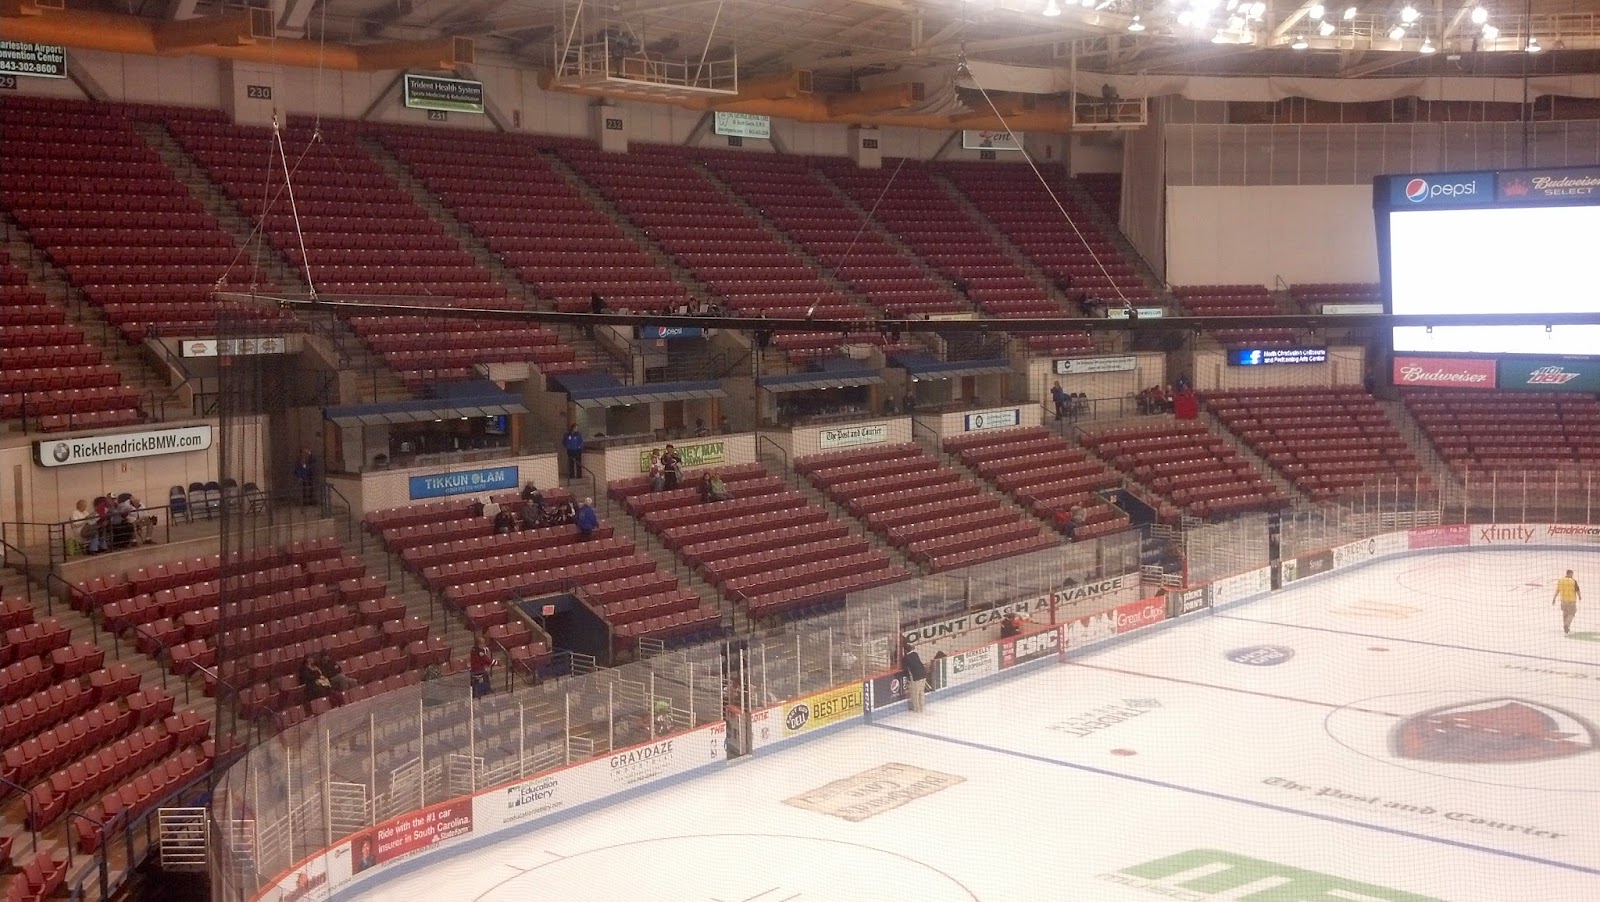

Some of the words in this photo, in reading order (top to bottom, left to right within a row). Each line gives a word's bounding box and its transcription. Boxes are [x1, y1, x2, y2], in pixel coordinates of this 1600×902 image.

[37, 53, 63, 63] Center
[0, 61, 57, 73] 843-302-8600
[250, 88, 270, 98] 230
[411, 80, 434, 90] Trident
[435, 82, 457, 92] Health
[458, 85, 480, 95] System
[431, 112, 445, 120] 231
[607, 120, 622, 129] 232
[1431, 180, 1476, 198] pepsi
[1544, 187, 1593, 196] SELECT
[667, 327, 683, 336] pepsi
[1400, 365, 1487, 383] Budweiser
[826, 431, 837, 441] The
[837, 430, 850, 441] Post
[851, 428, 860, 437] and
[861, 426, 882, 437] Courier
[73, 433, 202, 459] RickHendrickBMW.com
[703, 443, 724, 456] MAN
[425, 474, 468, 489] TIKKUN
[1480, 525, 1535, 543] xfinity
[974, 602, 1029, 625] CASH
[1117, 611, 1142, 627] Great
[813, 697, 839, 719] BEST
[841, 691, 862, 710] DELI
[791, 712, 806, 728] DELI
[610, 741, 673, 768] GRAYDAZE
[520, 780, 558, 796] Education
[521, 789, 554, 805] Lottery
[1262, 776, 1311, 792] The
[1315, 786, 1381, 805] Post
[1383, 800, 1438, 816] and
[1443, 811, 1569, 840] Courier
[378, 828, 394, 841] Ride
[395, 822, 411, 834] with
[412, 817, 424, 828] the
[426, 812, 436, 823] #1
[438, 808, 452, 819] car
[378, 839, 403, 854] insurer
[404, 834, 412, 843] in
[413, 828, 435, 840] South
[437, 816, 471, 832] Carolina.
